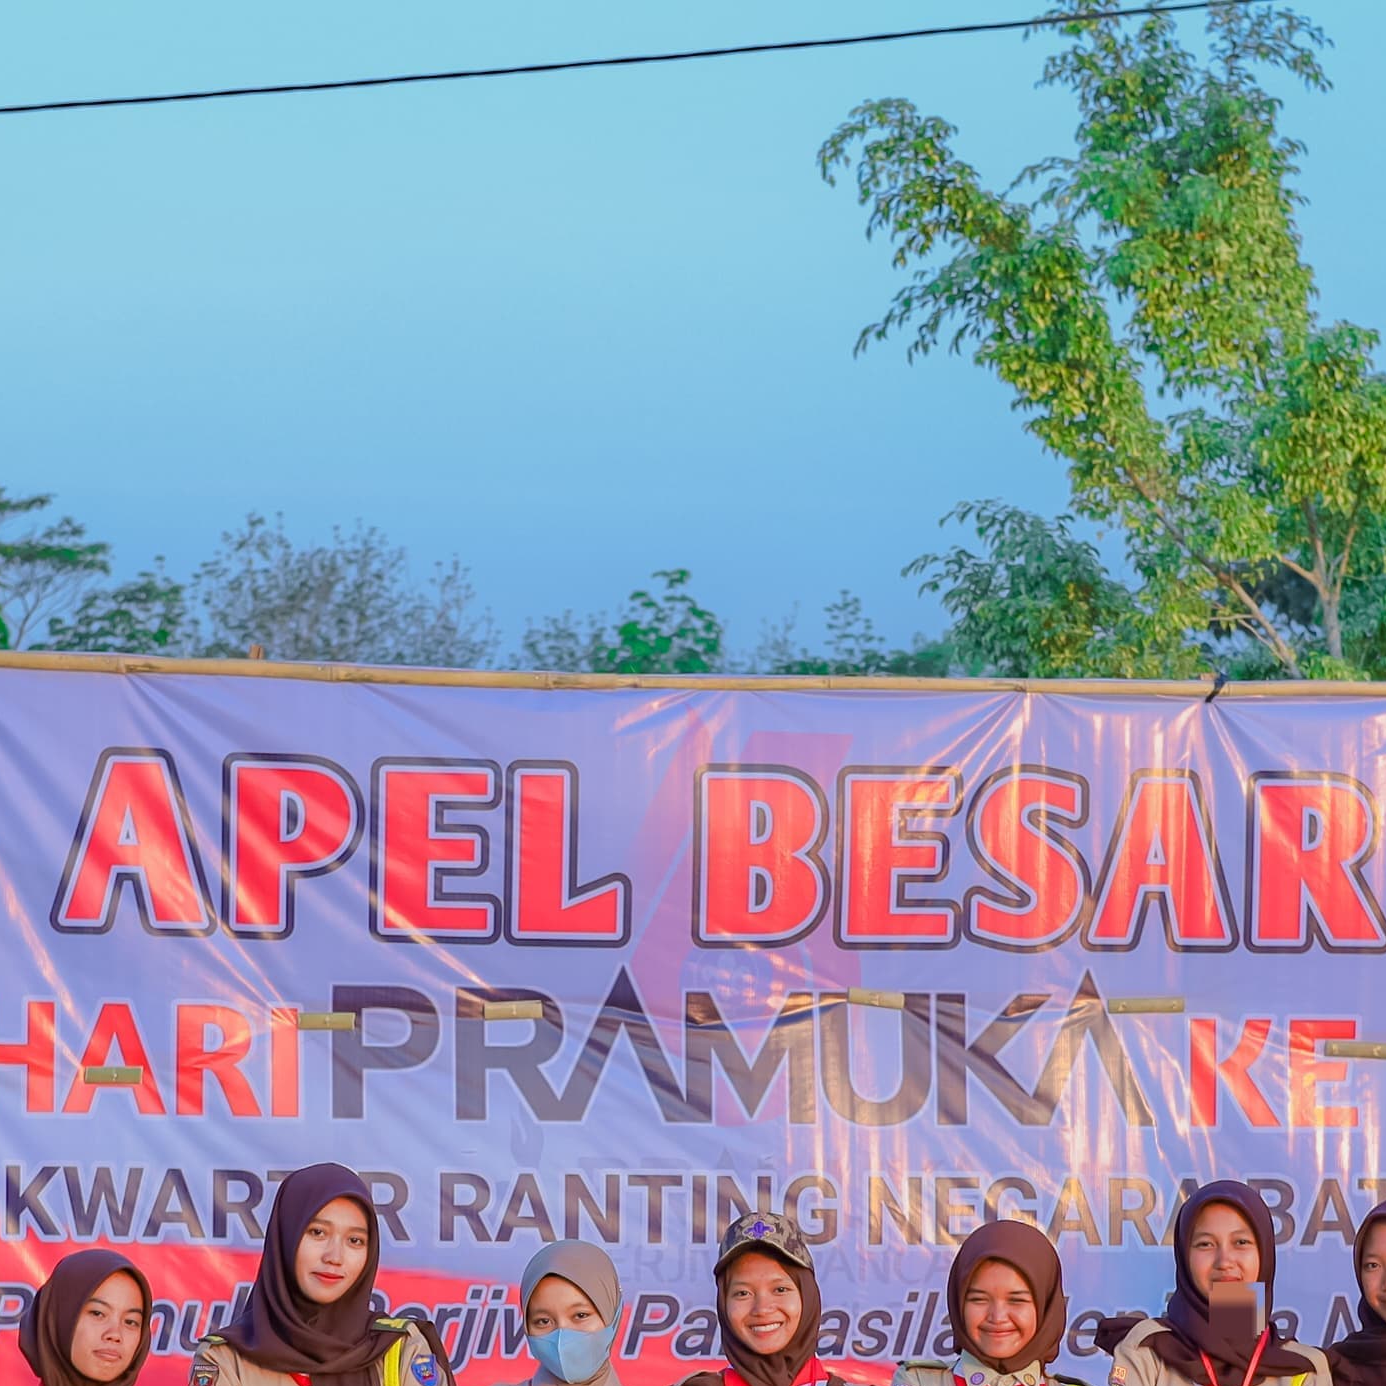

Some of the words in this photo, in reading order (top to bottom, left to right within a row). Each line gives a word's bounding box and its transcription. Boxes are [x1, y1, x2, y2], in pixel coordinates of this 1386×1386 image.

[50, 747, 631, 948] APEL
[330, 965, 1154, 1125] PRAMUKA
[1189, 1019, 1360, 1127] KE
[4, 1165, 410, 1241] KWARR
[441, 1173, 838, 1246] RANTING
[623, 1291, 955, 1357] Paasila
